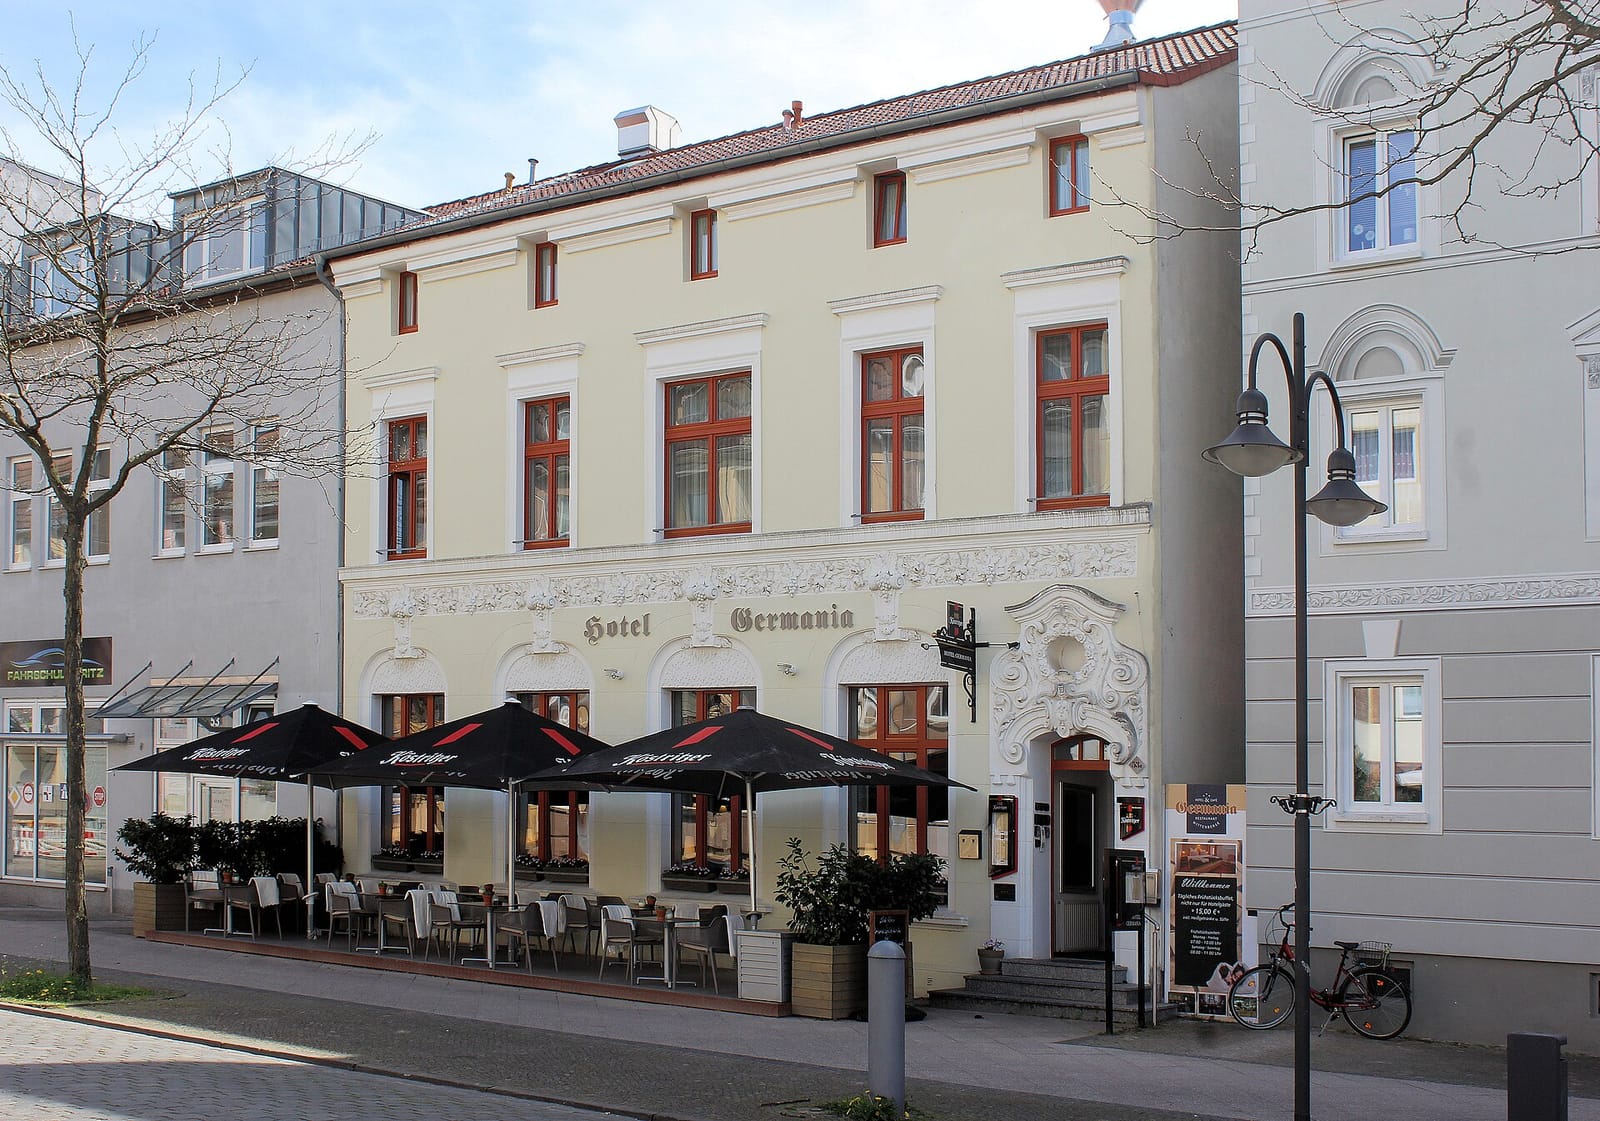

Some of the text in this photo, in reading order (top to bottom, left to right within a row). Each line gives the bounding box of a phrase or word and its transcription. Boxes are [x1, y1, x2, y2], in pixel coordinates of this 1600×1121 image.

[584, 603, 854, 646] Hotel Germania
[7, 667, 104, 680] FAHRSCHUL RITZ
[1175, 800, 1237, 815] Germania
[1181, 877, 1231, 889] Willkommen
